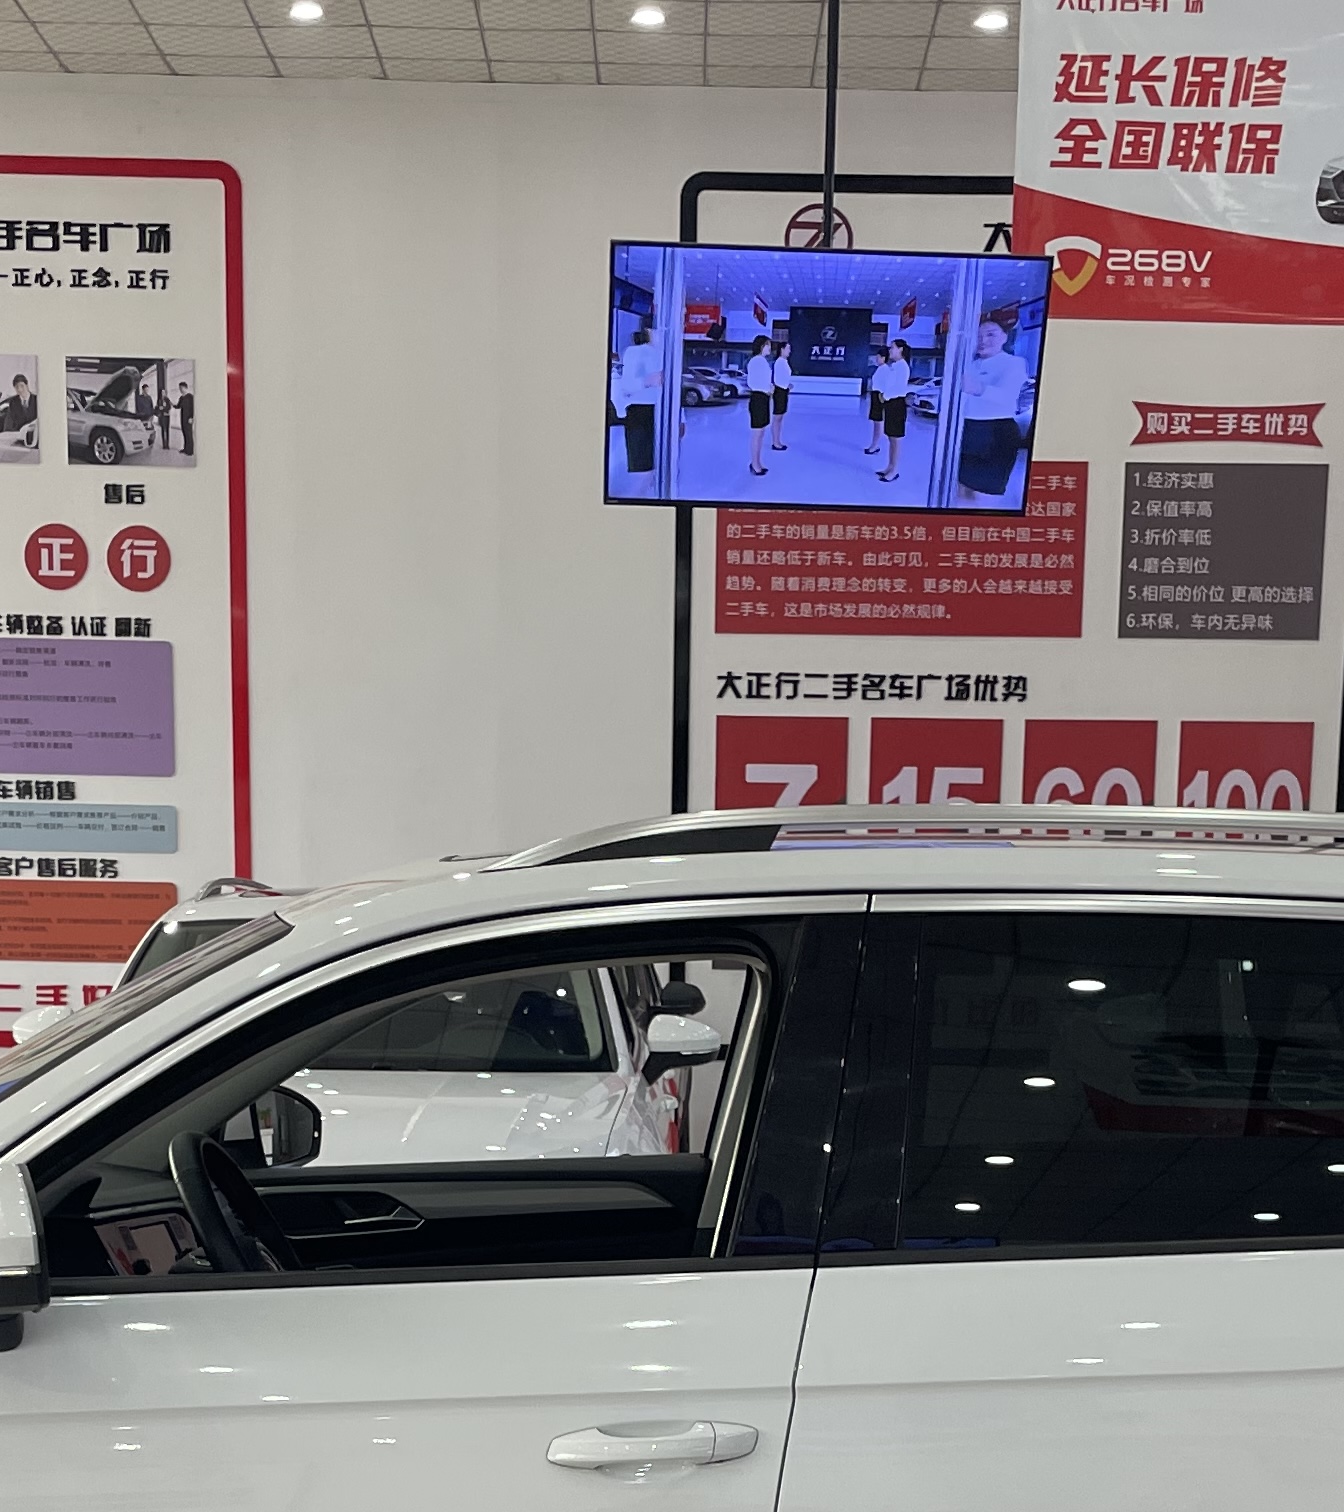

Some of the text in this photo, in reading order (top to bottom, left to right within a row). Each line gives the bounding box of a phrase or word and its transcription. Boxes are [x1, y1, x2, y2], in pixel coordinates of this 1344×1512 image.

[1053, 53, 1288, 108] 延长保修
[1050, 117, 1284, 175] 全国联保
[1106, 248, 1214, 273] 268V
[1146, 412, 1309, 436] 购买二手车优势
[1134, 471, 1215, 489] 1.经济实惠
[103, 483, 146, 505] 售后
[1131, 500, 1214, 518] 2.保值率高
[1130, 528, 1213, 546] 3.折价率低
[1128, 556, 1210, 575] 4.磨合到位
[1127, 585, 1314, 604] 5.相同的价位 更高的选择
[71, 616, 106, 636] 认证
[716, 672, 1028, 702] 大正行二手名车广场优势
